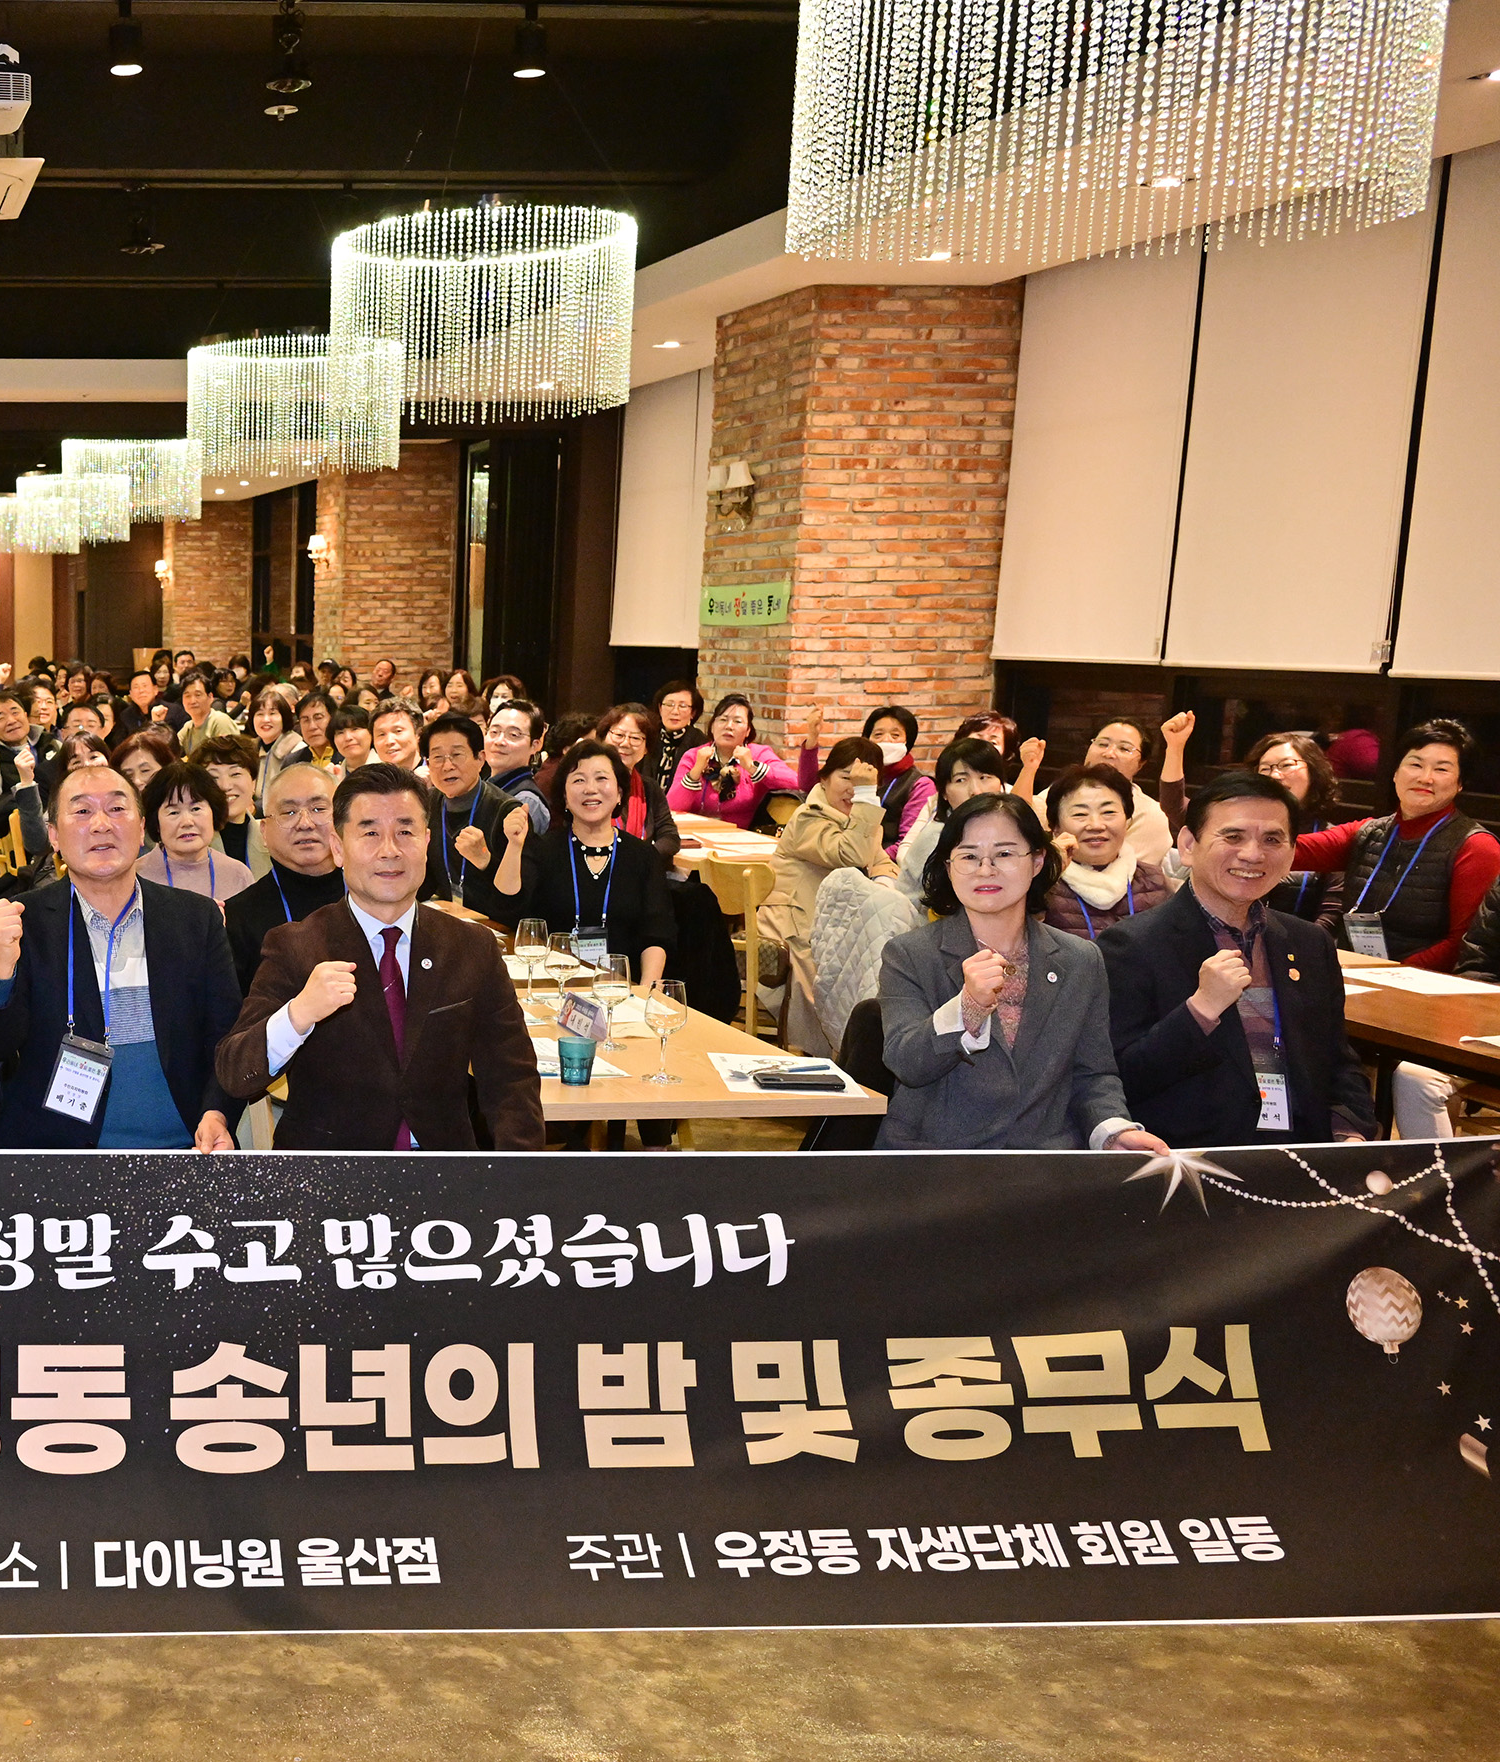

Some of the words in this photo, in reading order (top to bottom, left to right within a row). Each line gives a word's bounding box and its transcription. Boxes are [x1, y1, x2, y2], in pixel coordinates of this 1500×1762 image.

[142, 1214, 302, 1291] 수고
[321, 1213, 796, 1290] 많으셨습니다
[170, 1341, 541, 1475] 송년의
[578, 1341, 698, 1469] 밤
[731, 1339, 860, 1466] 및
[886, 1323, 1272, 1462] 종무식
[93, 1539, 285, 1590] 다이닝원
[296, 1537, 442, 1587] 울산점
[566, 1533, 665, 1581] 주관
[714, 1528, 861, 1578] 우정동
[866, 1522, 1071, 1573] 자생단체
[1069, 1519, 1180, 1566] 회원
[1178, 1515, 1286, 1564] 일동
